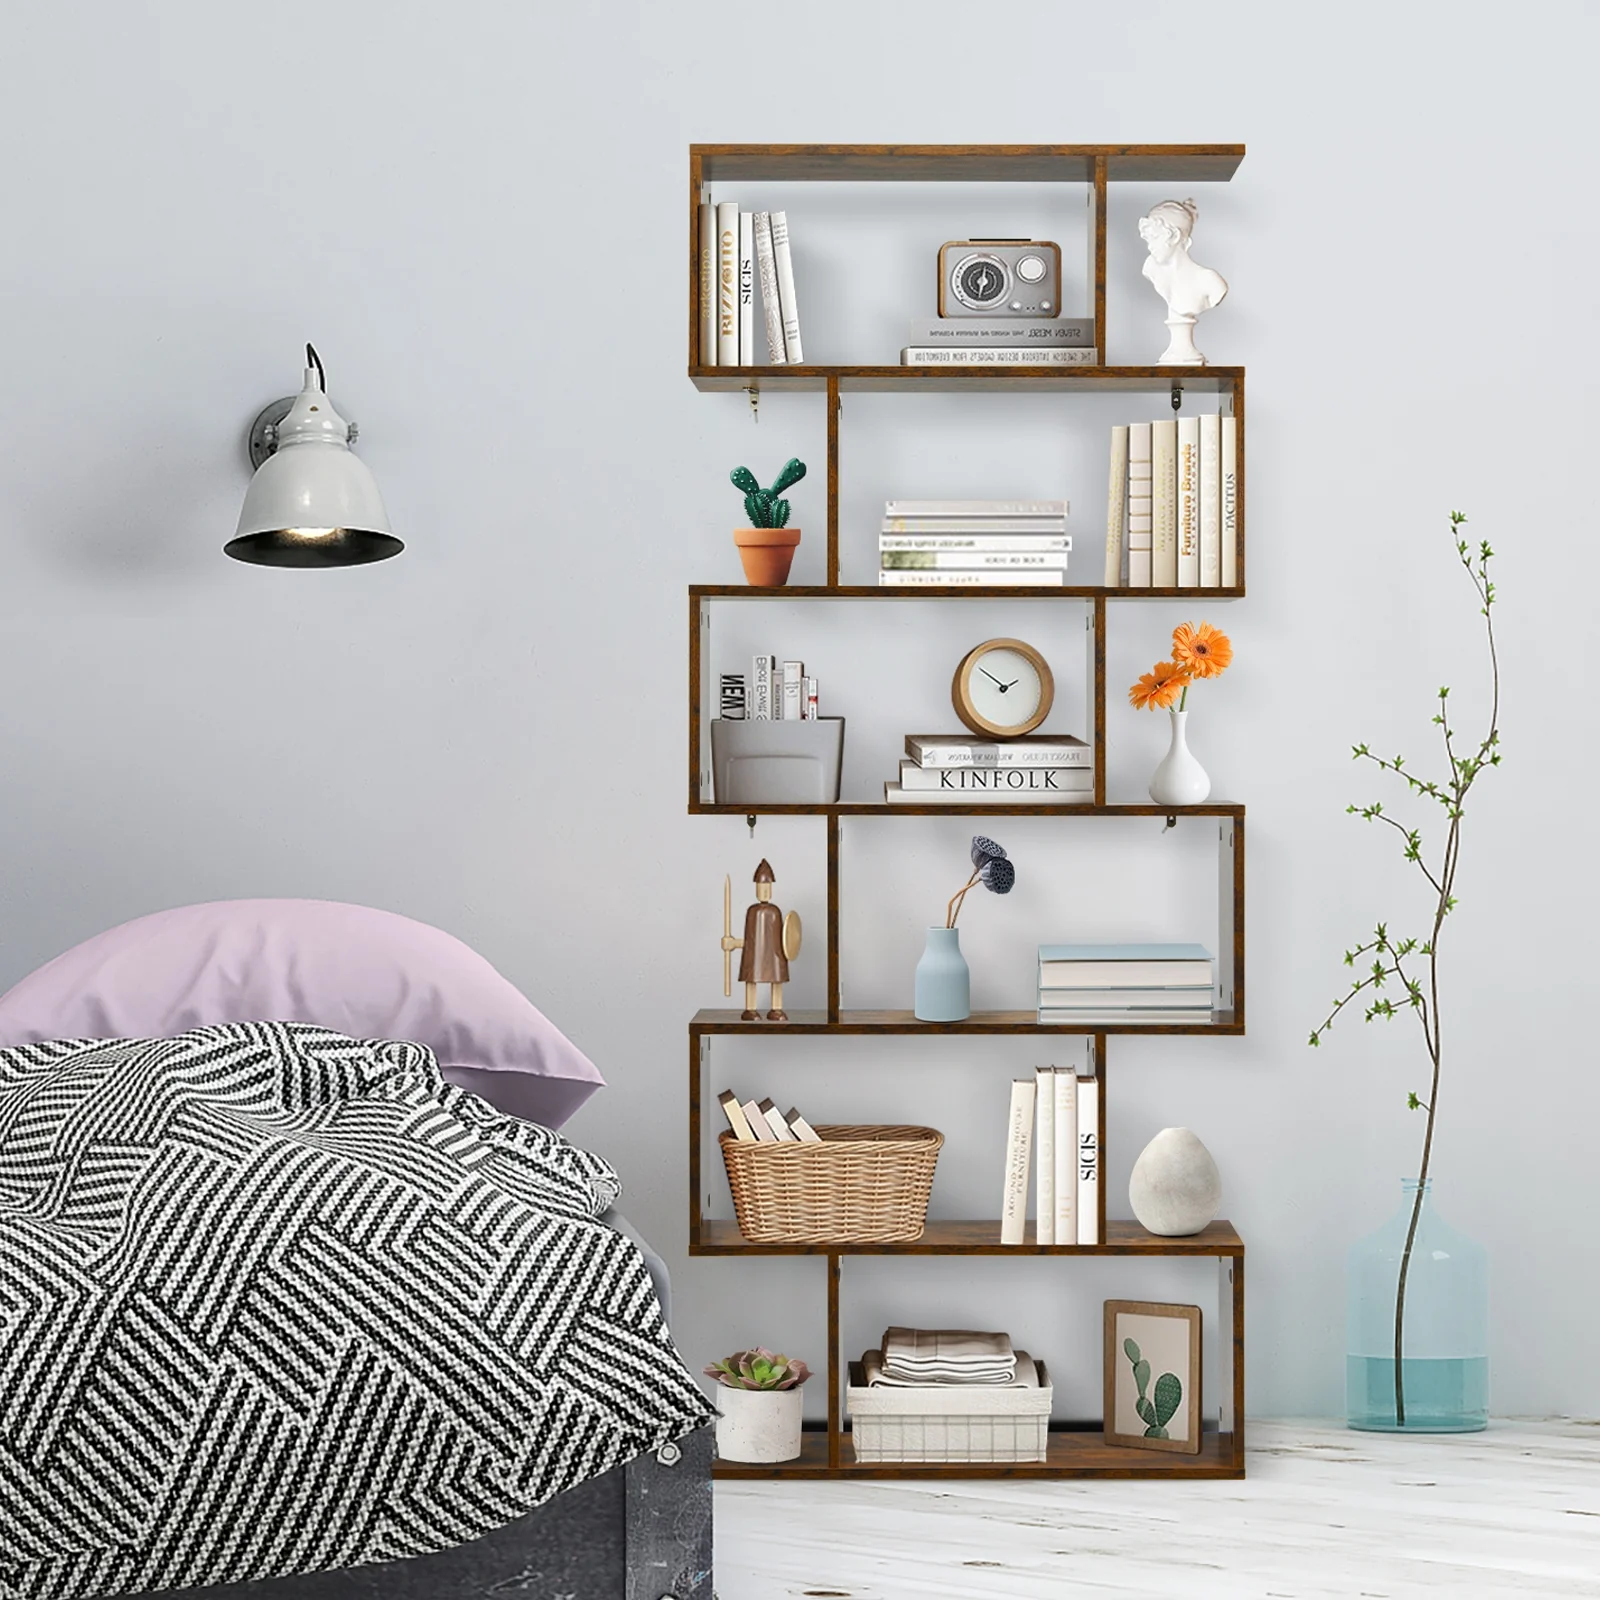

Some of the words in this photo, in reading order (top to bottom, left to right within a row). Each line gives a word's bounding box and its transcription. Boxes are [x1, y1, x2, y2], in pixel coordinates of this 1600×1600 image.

[742, 259, 751, 304] SICIS
[1181, 443, 1191, 491] Brands
[1181, 495, 1191, 556] Furniture
[1225, 472, 1235, 532] TACITUS
[940, 770, 1060, 789] KINFOLK
[1080, 1133, 1096, 1181] SICIS
[1007, 1172, 1018, 1218] AROUND
